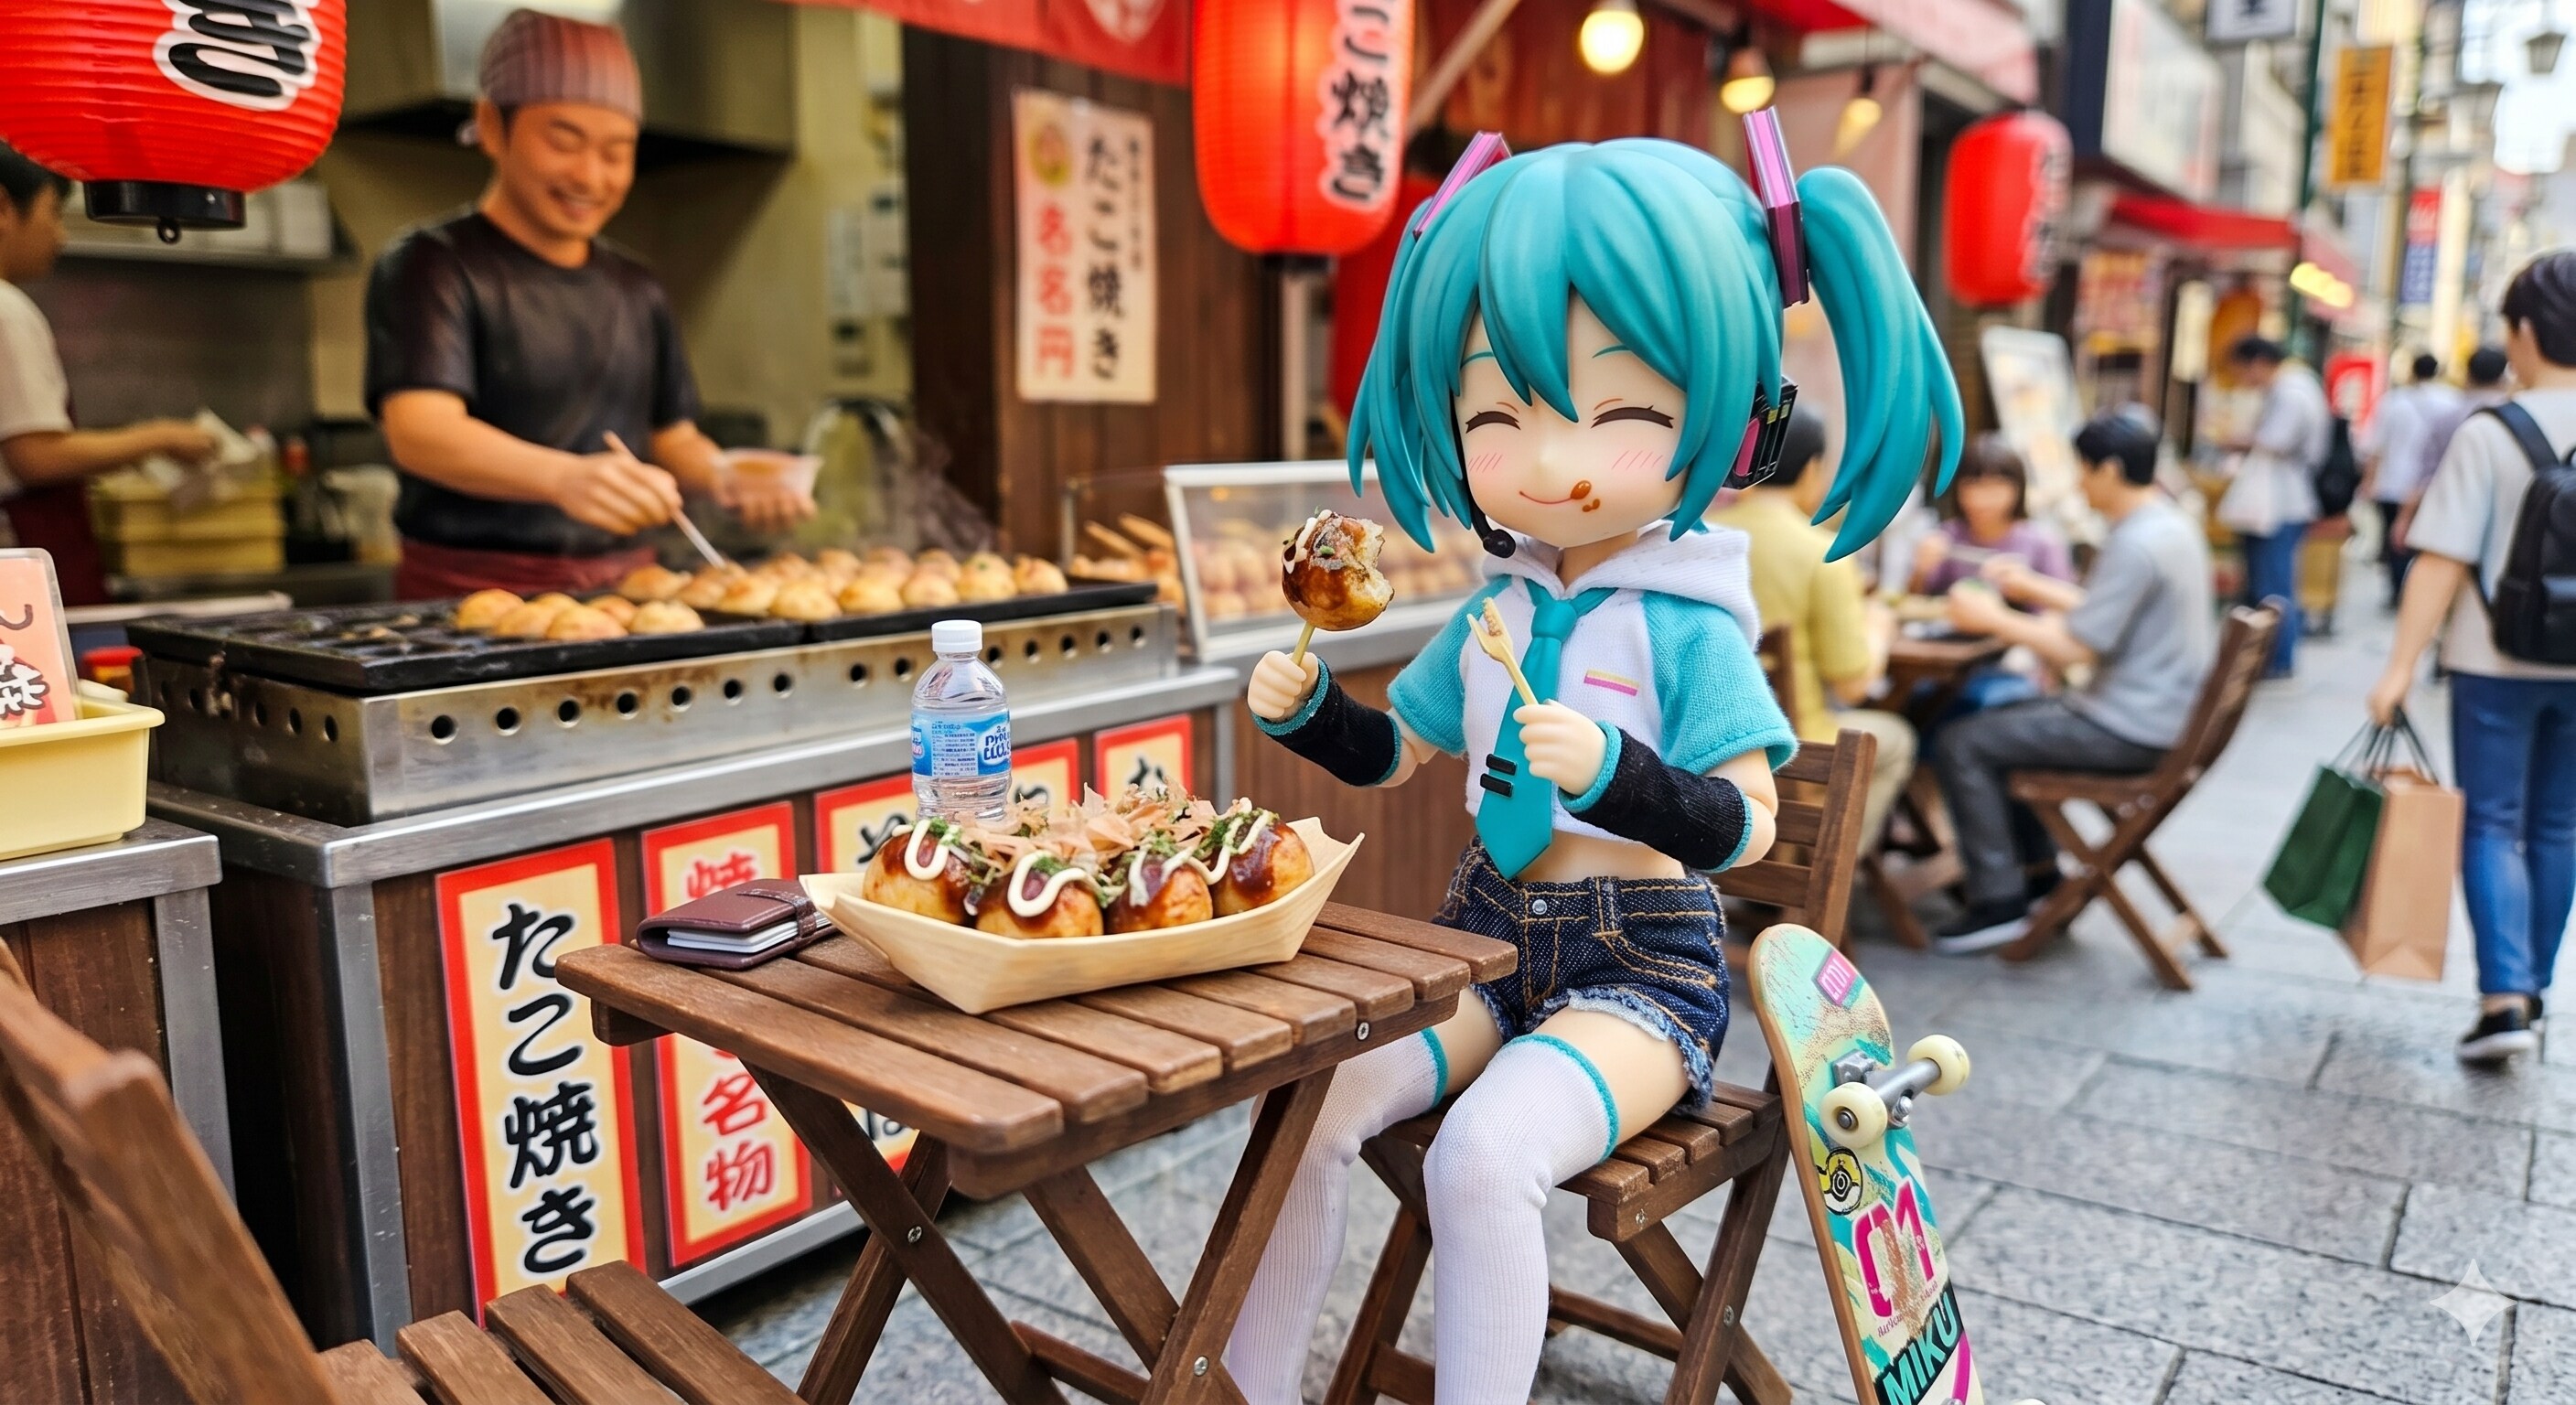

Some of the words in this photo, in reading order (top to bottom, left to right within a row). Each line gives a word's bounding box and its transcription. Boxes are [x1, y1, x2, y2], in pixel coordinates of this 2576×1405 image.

[492, 902, 599, 1274] たこ焼き
[1882, 1291, 1958, 1405] MIKU
